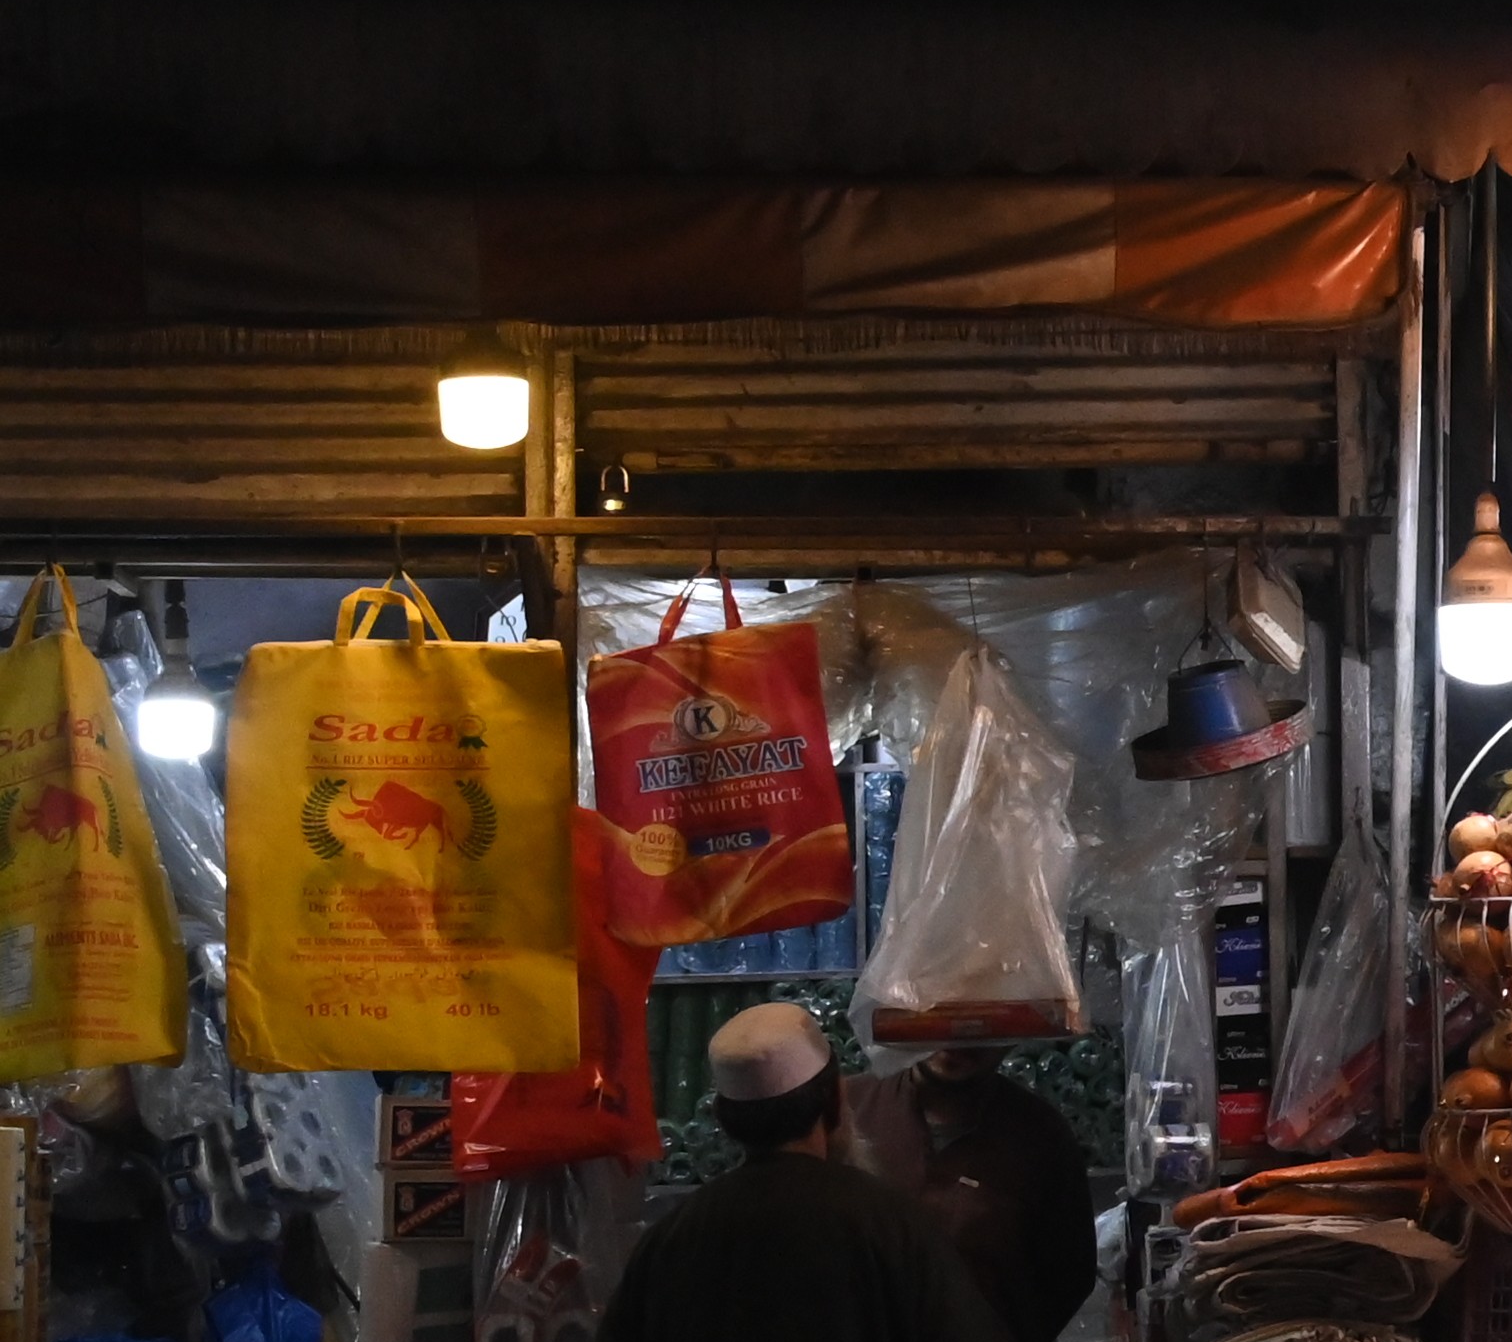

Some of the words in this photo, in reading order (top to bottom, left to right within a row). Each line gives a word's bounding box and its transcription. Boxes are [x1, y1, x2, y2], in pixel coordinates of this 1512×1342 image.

[308, 714, 456, 743] Sada
[691, 705, 719, 735] K
[635, 735, 808, 794] KEFAYAT
[741, 776, 777, 791] GRAIN
[690, 794, 751, 817] WHITE
[758, 786, 804, 807] RICE
[705, 831, 753, 853] 10KG
[303, 1003, 350, 1018] 18.1
[359, 1003, 388, 1020] kg
[445, 1003, 472, 1017] 40
[479, 1003, 501, 1017] lb
